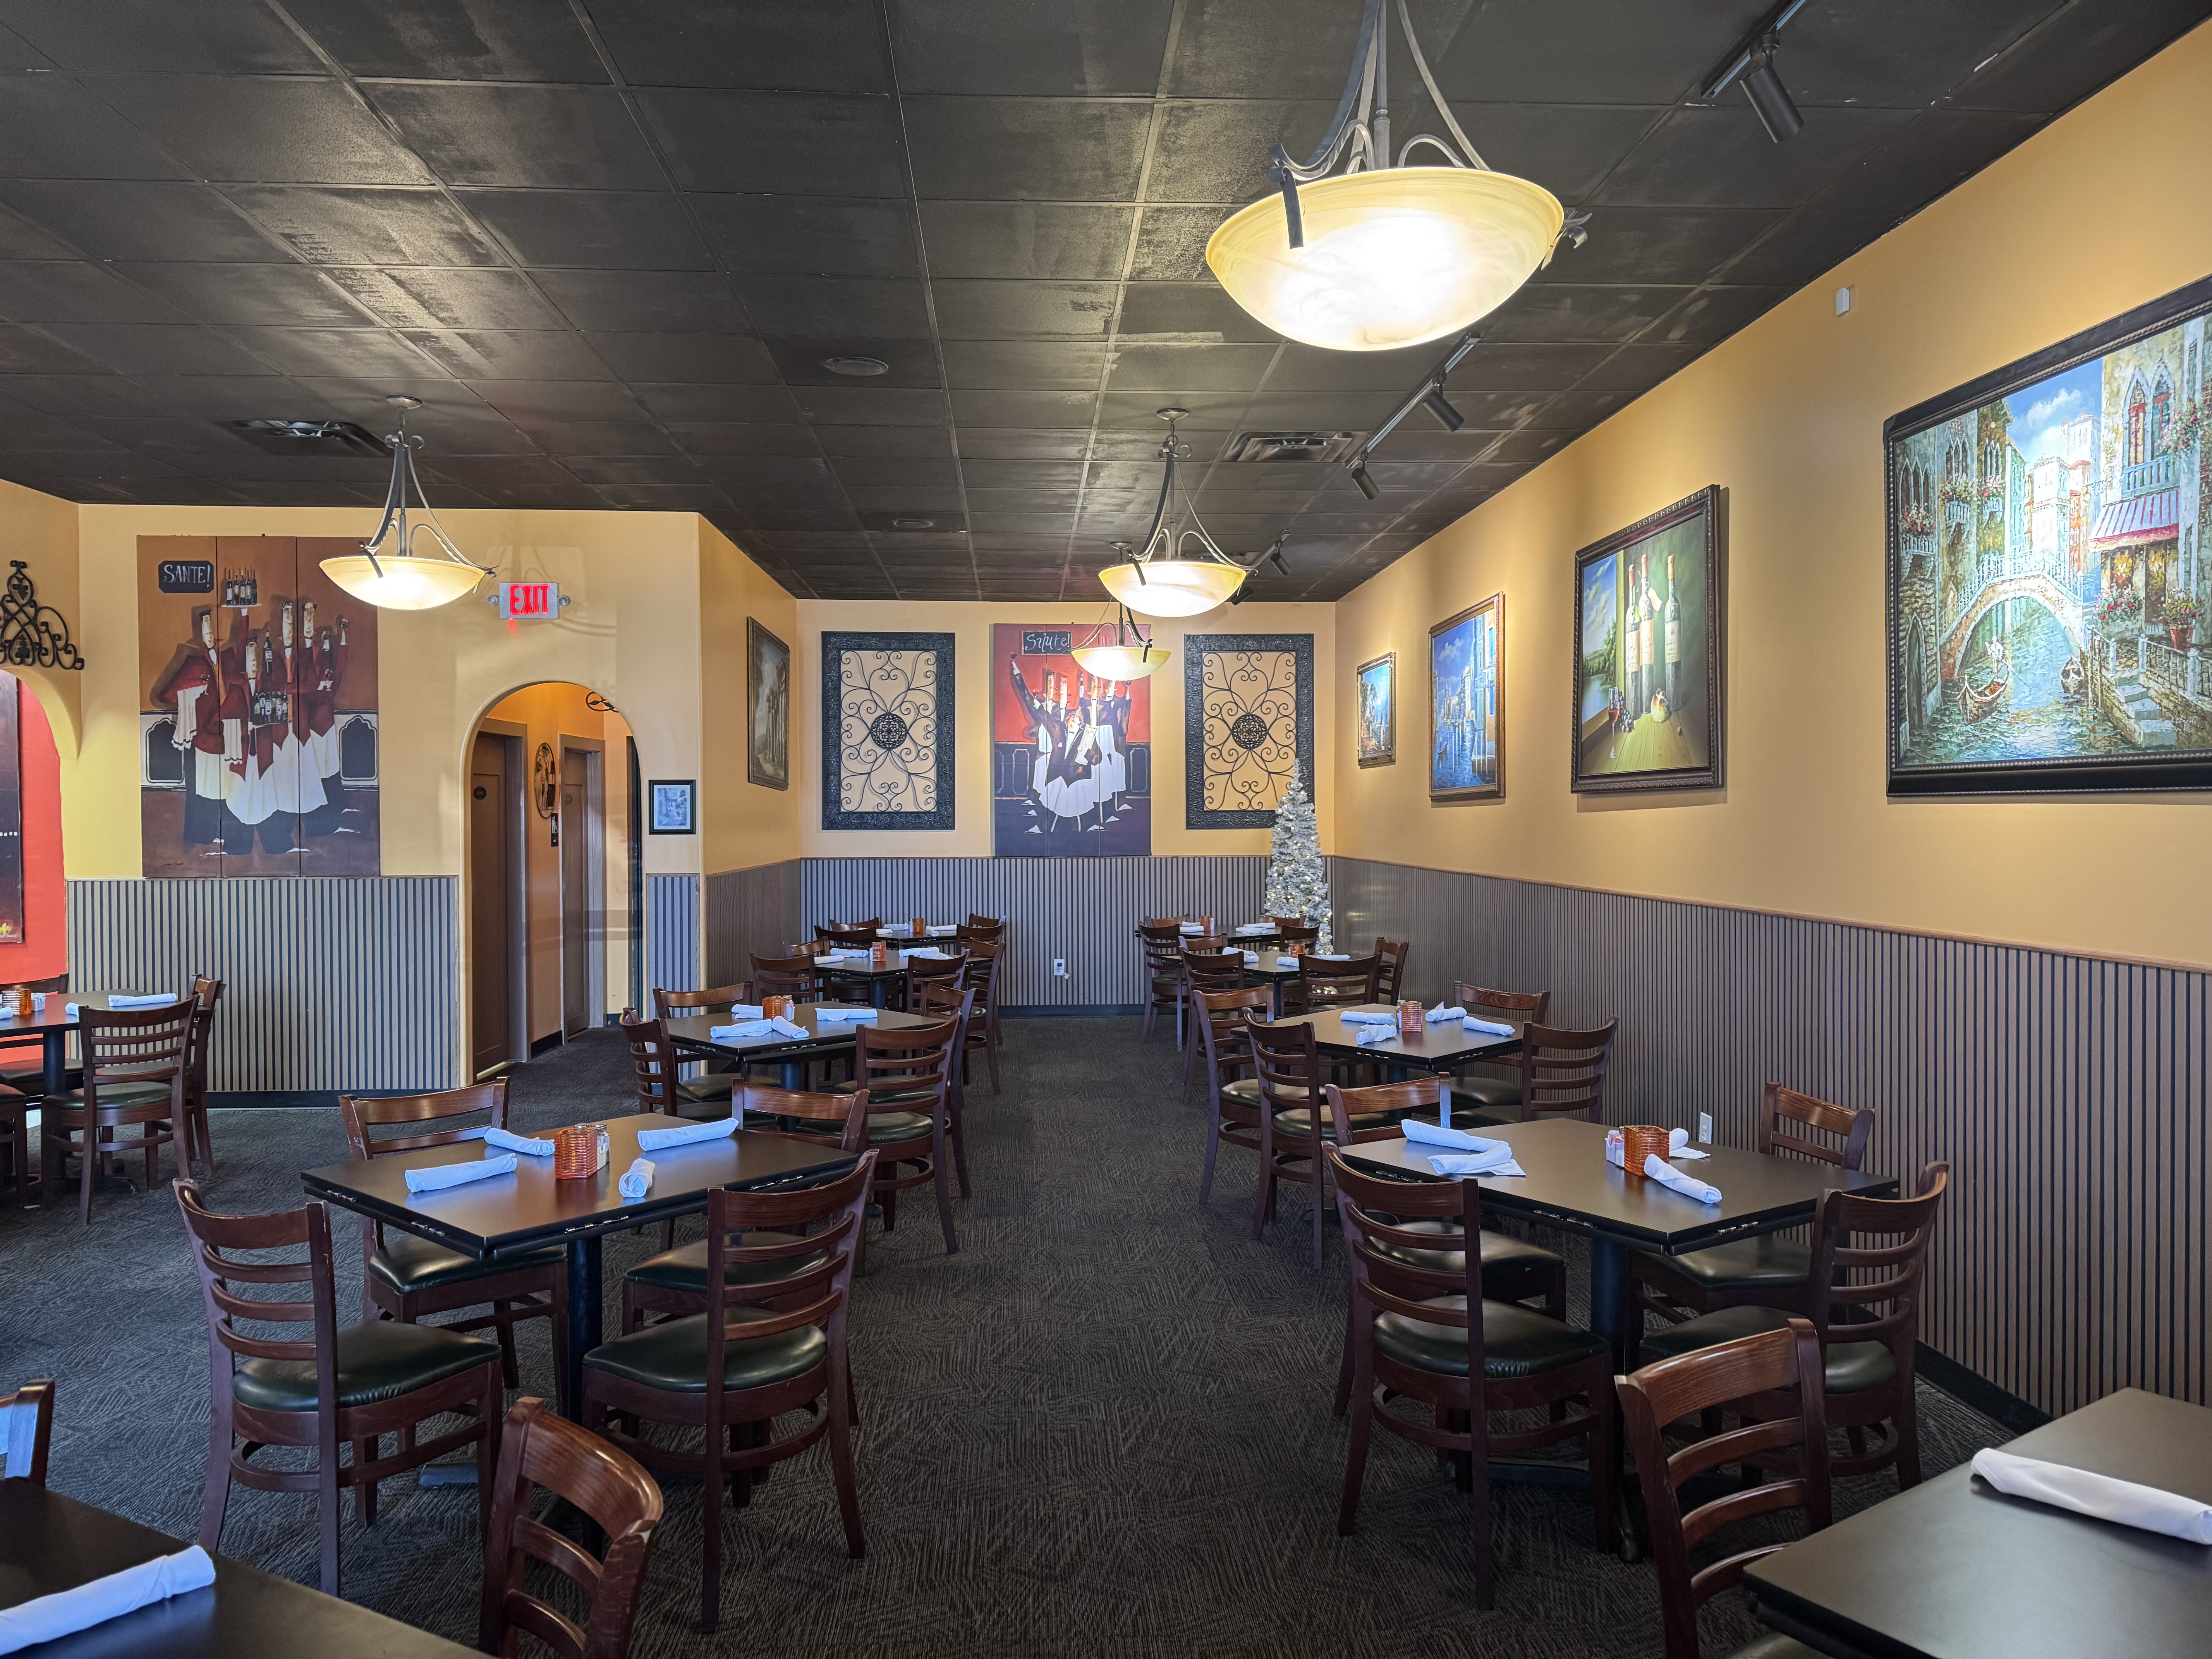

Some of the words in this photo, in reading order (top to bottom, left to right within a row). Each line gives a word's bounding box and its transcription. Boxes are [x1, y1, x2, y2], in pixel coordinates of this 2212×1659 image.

[163, 565, 210, 588] SANTE!
[510, 584, 551, 615] EXIT
[1025, 632, 1070, 652] Salute!
